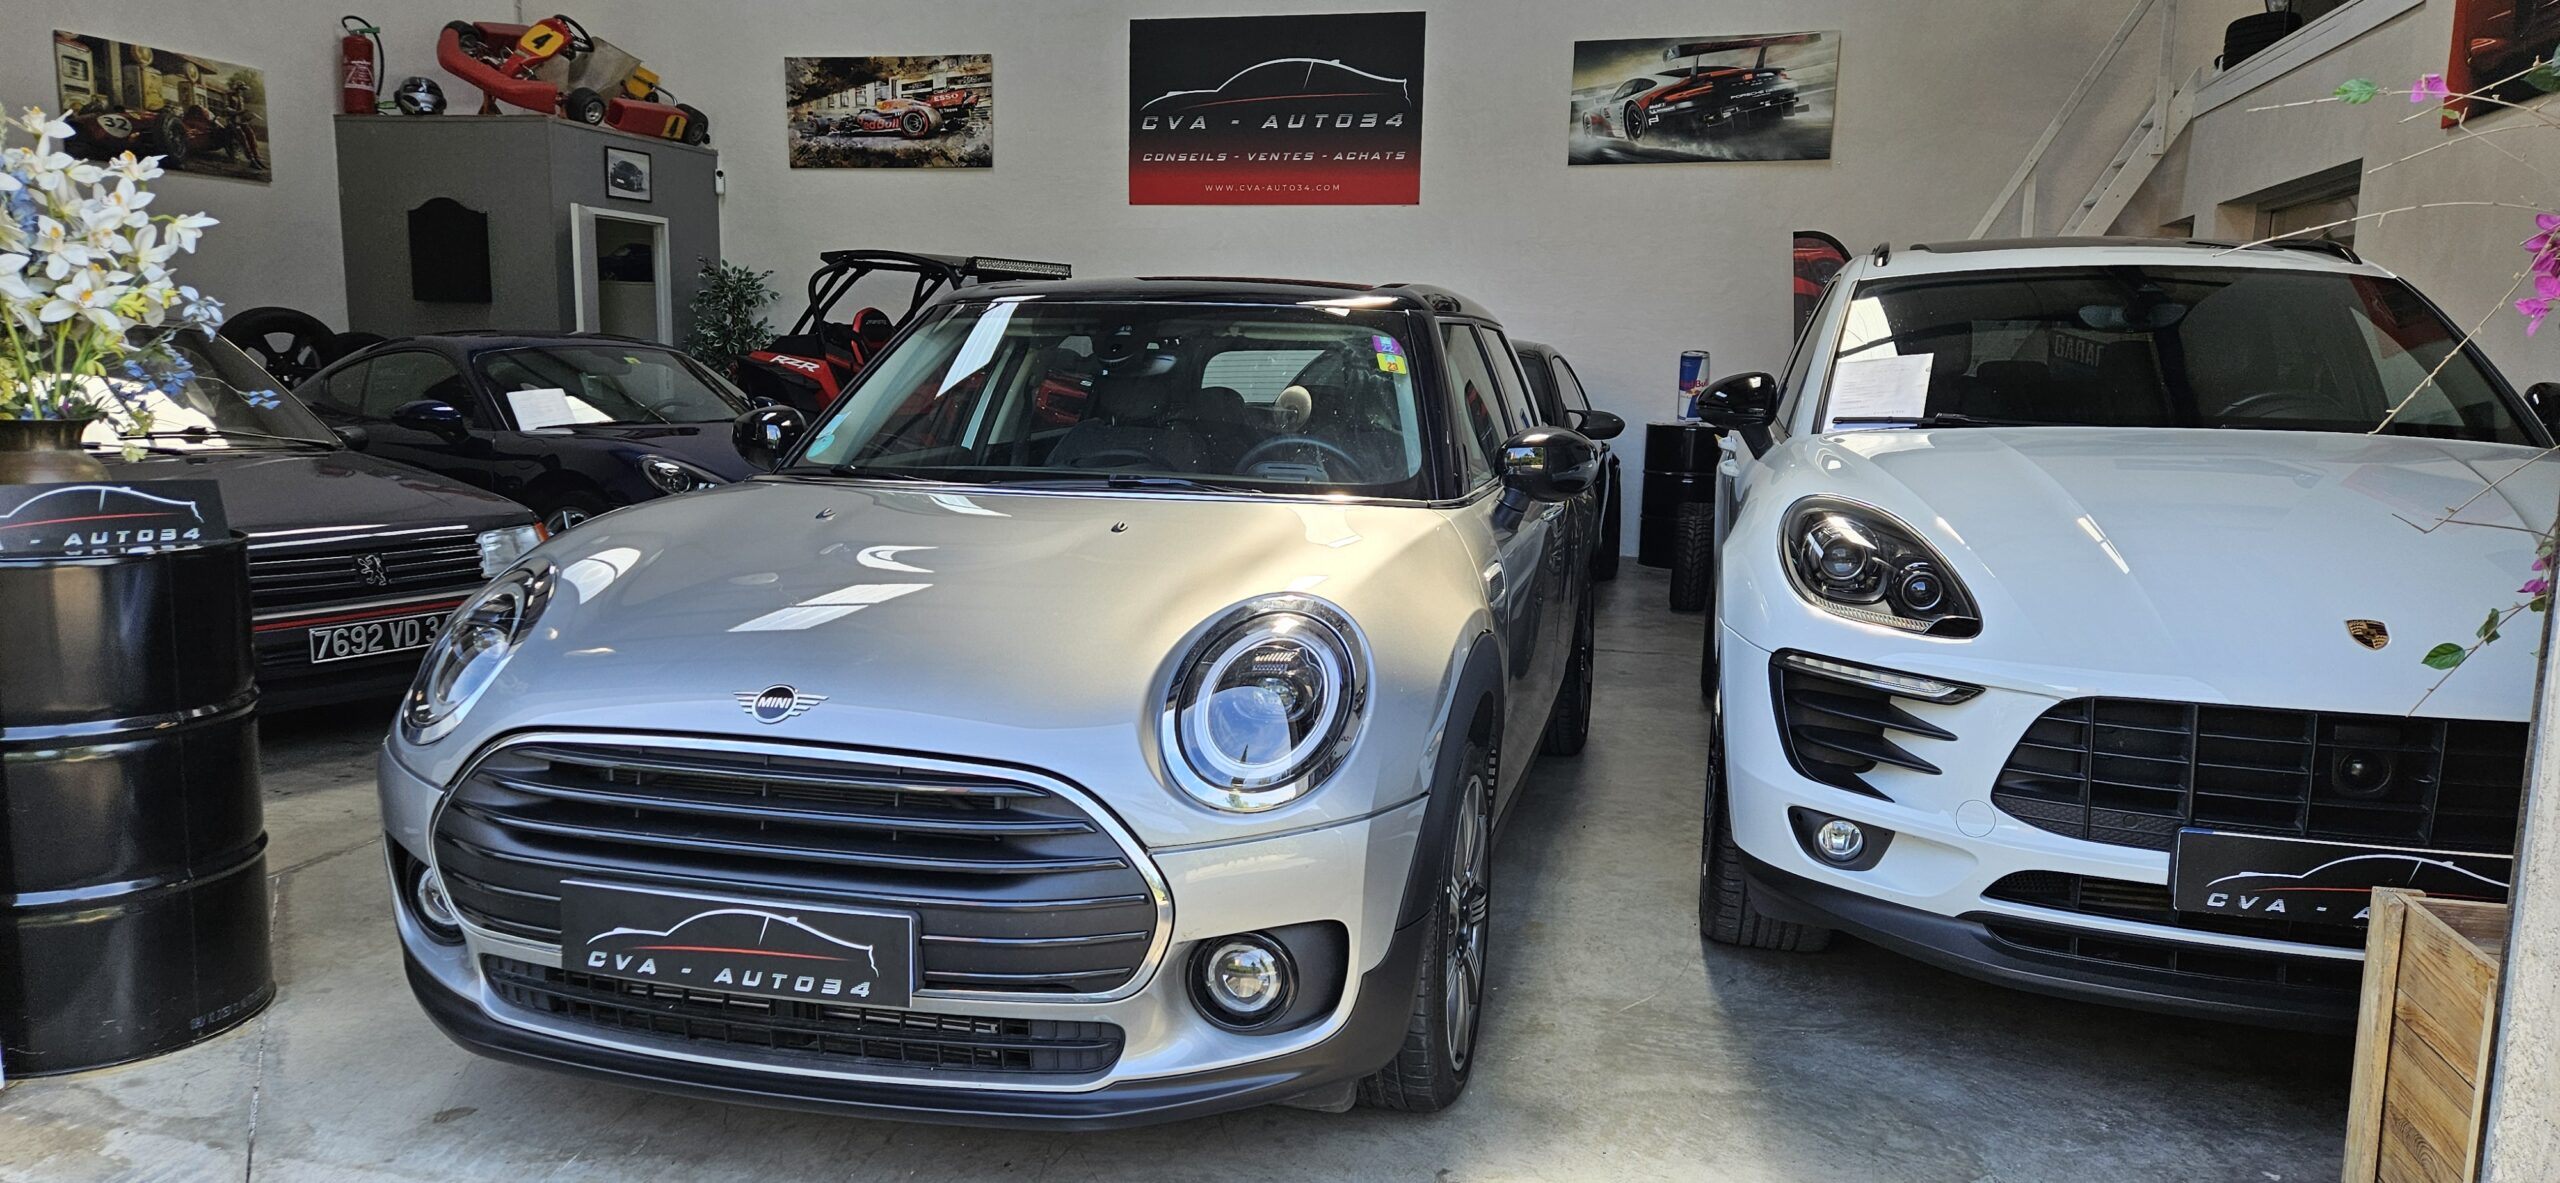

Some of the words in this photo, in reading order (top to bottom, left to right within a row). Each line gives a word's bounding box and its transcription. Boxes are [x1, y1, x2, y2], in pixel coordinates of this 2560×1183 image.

[532, 33, 553, 49] 4
[933, 93, 959, 102] ESSO
[103, 116, 130, 132] 32
[668, 116, 680, 137] 4
[1141, 115, 1207, 130] CVA
[1261, 112, 1405, 130] AUTO34
[1142, 152, 1228, 162] CONSEILS
[1247, 151, 1315, 161] VENTES
[1332, 151, 1407, 161] ACHATS
[1204, 183, 1341, 192] WWW.CVA-AUTO34.COM
[769, 355, 821, 372] RZR
[64, 527, 201, 546] AUTO34
[314, 623, 384, 660] 7692
[388, 619, 421, 649] VD
[757, 696, 793, 709] MINI
[2206, 892, 2286, 913] CVA
[587, 950, 657, 975] CVA
[714, 967, 872, 998] AUTO34
